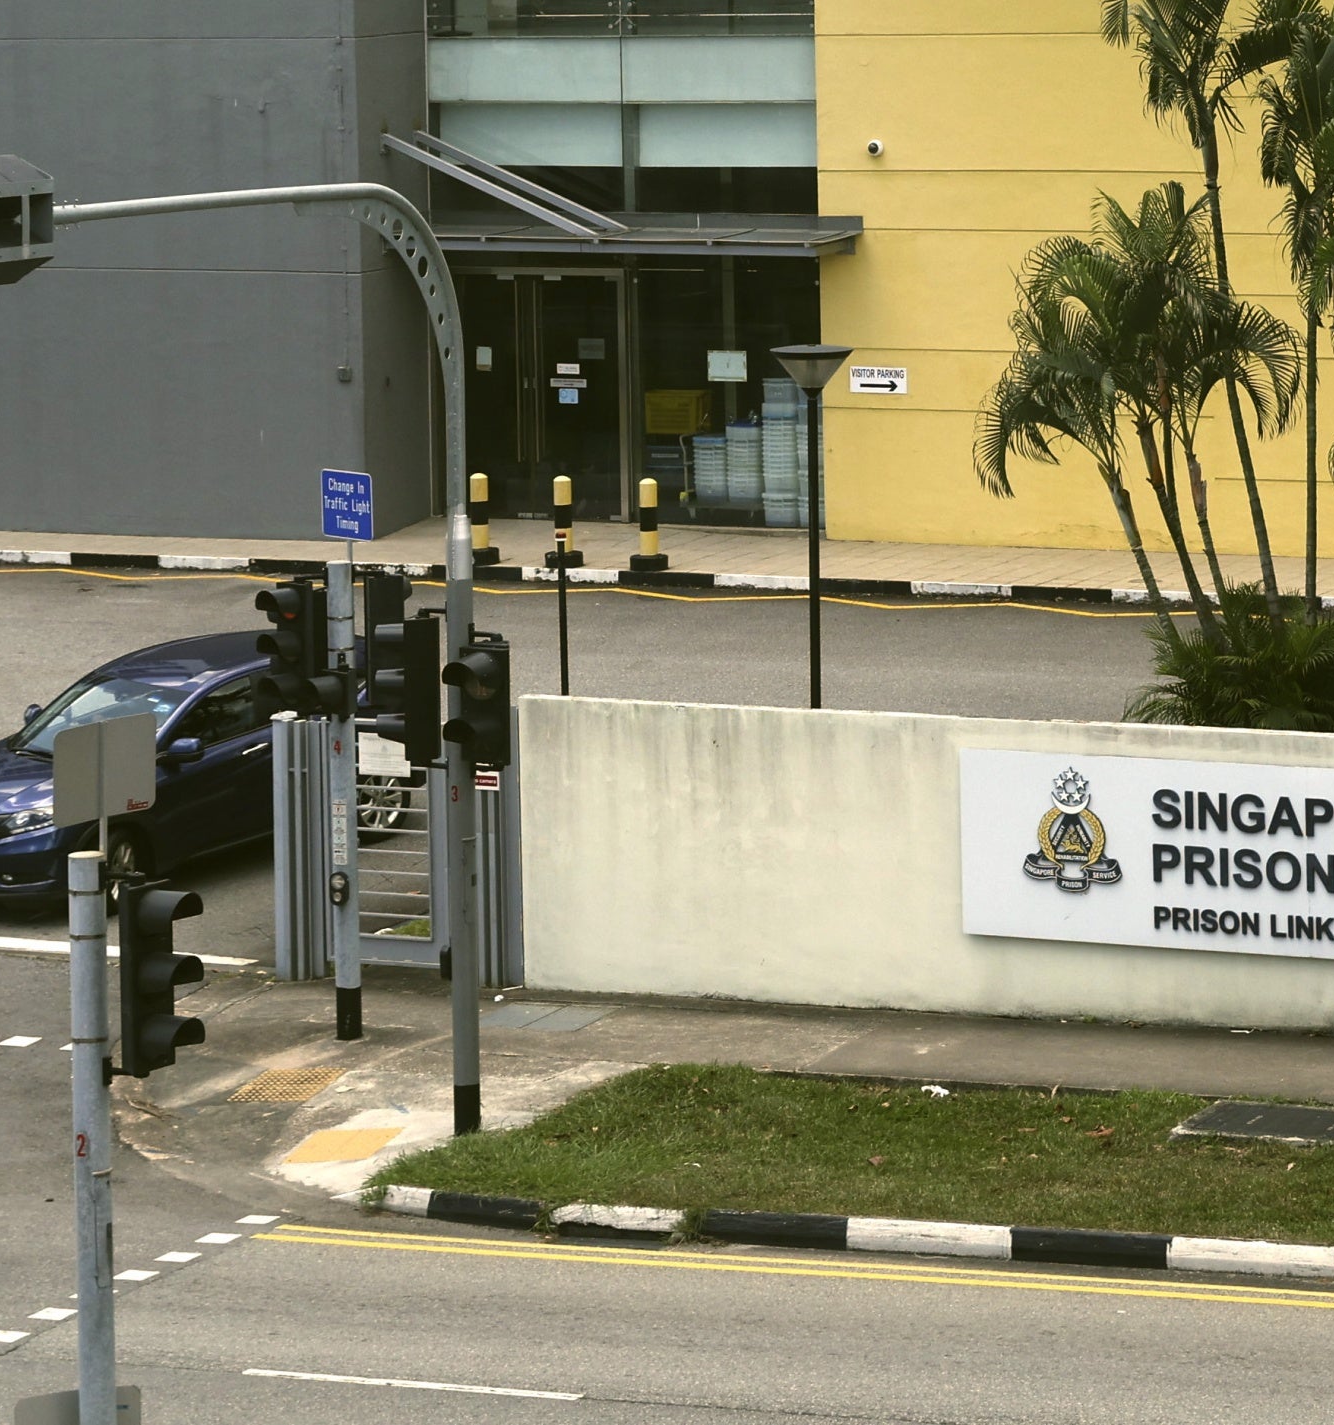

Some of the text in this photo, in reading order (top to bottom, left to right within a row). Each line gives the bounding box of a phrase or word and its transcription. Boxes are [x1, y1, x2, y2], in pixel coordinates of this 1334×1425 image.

[851, 368, 904, 379] VISITOR PARKING
[328, 477, 354, 496] Change
[324, 495, 370, 516] Traffic Light
[336, 515, 359, 534] Timing
[333, 740, 342, 755] 4
[451, 785, 458, 802] 3
[1024, 863, 1055, 876] SINGAPORE
[1092, 871, 1117, 879] SERVICE
[1061, 880, 1083, 888] PRISON
[1154, 906, 1260, 937] PRISON
[76, 1133, 86, 1157] 2
